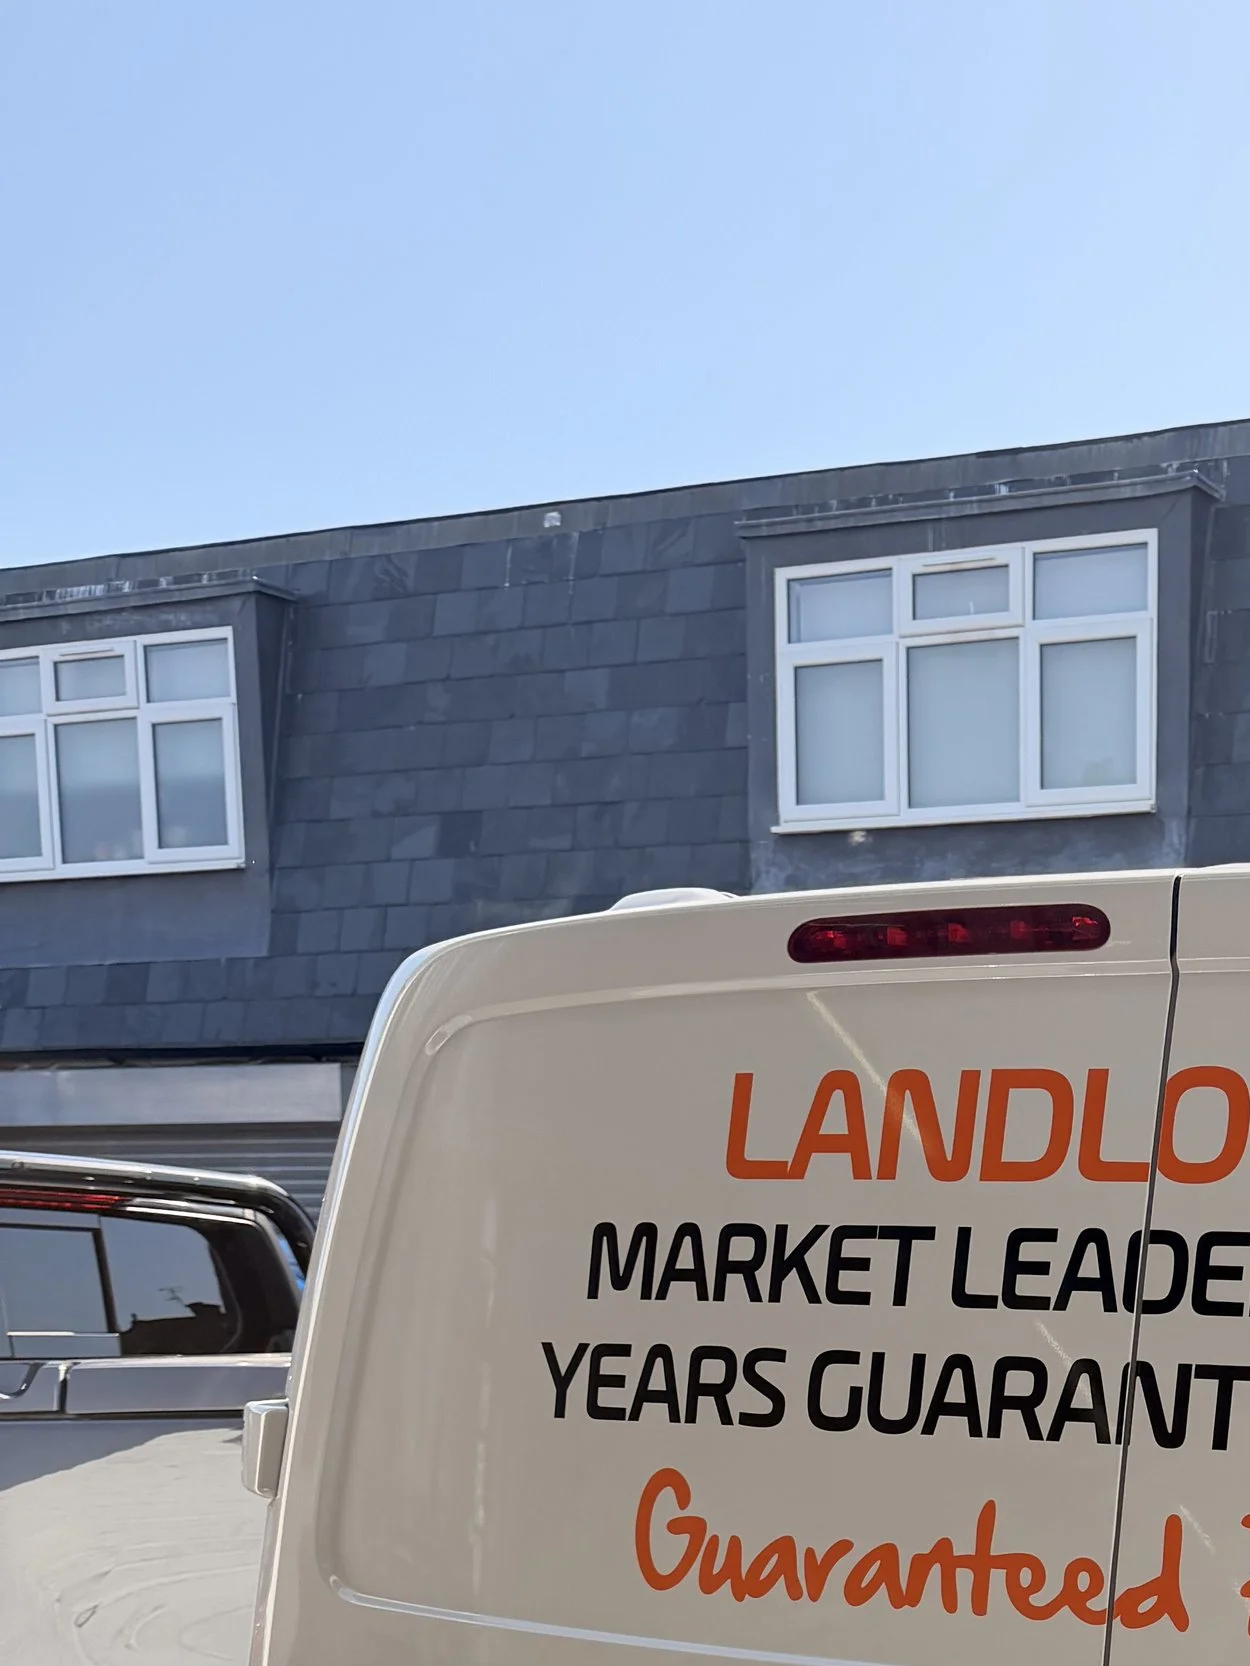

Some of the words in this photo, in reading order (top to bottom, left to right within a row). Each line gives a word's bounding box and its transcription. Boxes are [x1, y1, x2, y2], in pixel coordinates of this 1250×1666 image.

[586, 1221, 936, 1307] MARKET
[540, 1342, 786, 1428] YEARS
[636, 1468, 1190, 1632] Guaranteed
